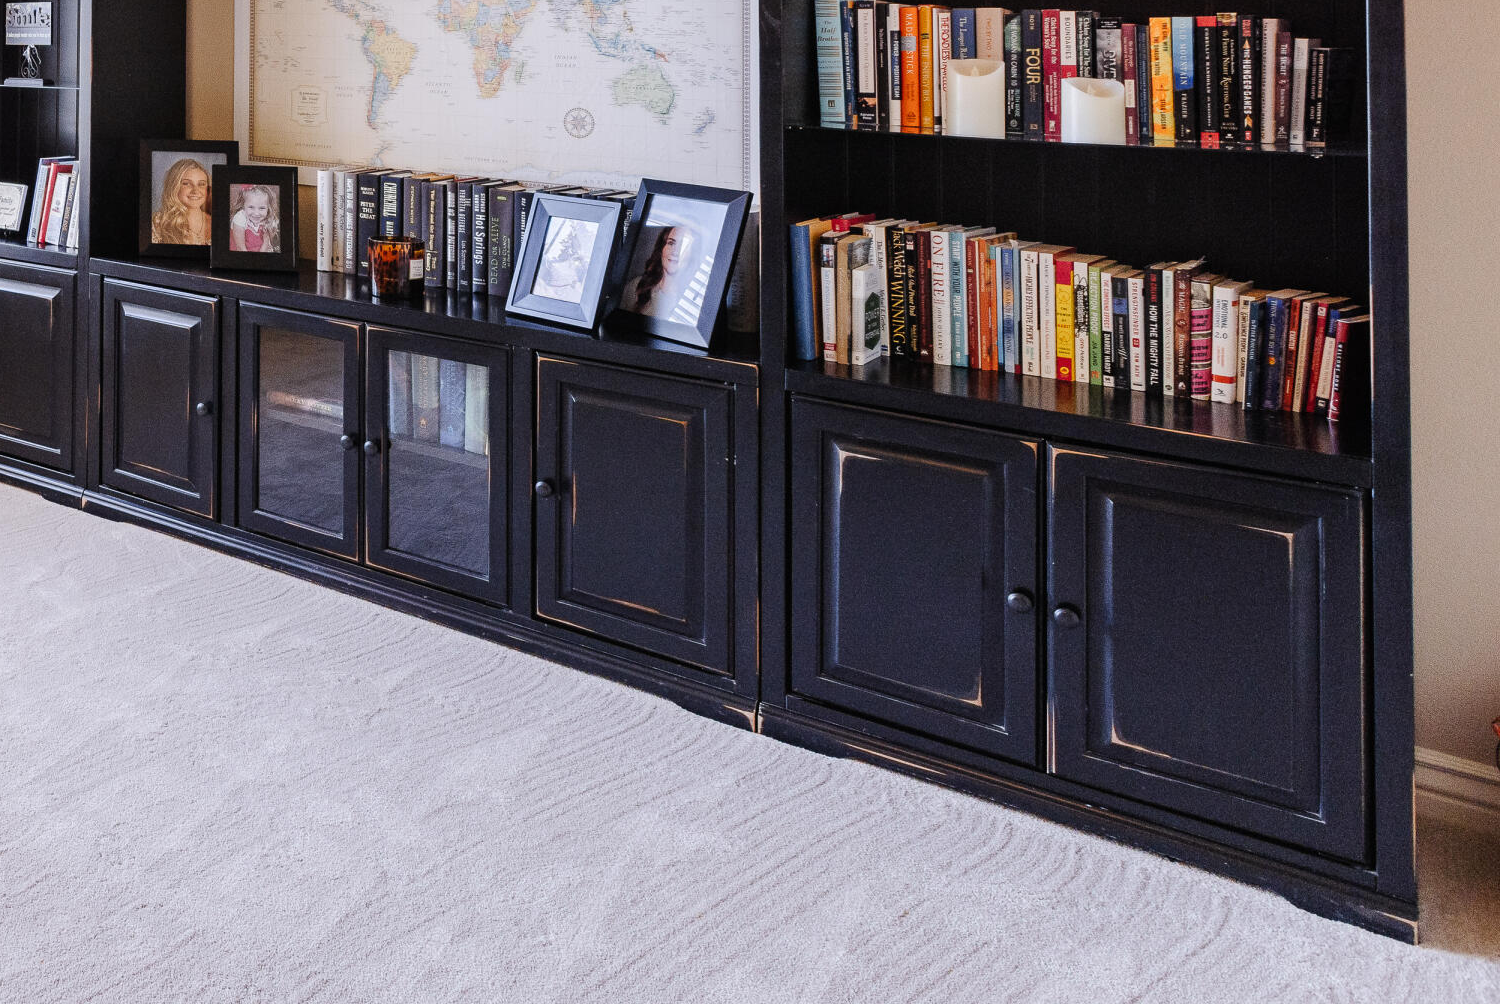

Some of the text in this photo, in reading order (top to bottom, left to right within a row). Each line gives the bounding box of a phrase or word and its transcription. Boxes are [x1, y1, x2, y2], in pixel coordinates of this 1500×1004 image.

[9, 7, 45, 26] Smile
[941, 17, 950, 60] THE ROAD LESS
[958, 17, 967, 46] The Longest
[906, 51, 914, 74] STICK
[1026, 48, 1041, 84] FOUR
[1180, 44, 1188, 85] MOUNTAIN
[1243, 49, 1251, 58] THE
[1243, 60, 1251, 89] HUNGER
[1243, 91, 1251, 115] GAMES
[384, 182, 397, 217] CHURCHILL
[474, 214, 485, 265] Hot Springs
[490, 217, 499, 284] DEAD OR ALIVE
[932, 235, 943, 256] ON
[952, 240, 961, 259] START
[933, 262, 944, 297] FIRE
[952, 261, 960, 277] WITH
[890, 230, 906, 344] Jack Welch WINNING
[953, 278, 961, 294] YOUR
[1025, 276, 1034, 294] HIGHLY
[1090, 271, 1098, 311] REJECTION
[954, 295, 962, 317] PEOPLE
[1026, 296, 1034, 324] EFFECTIVE
[1149, 305, 1157, 321] HOW
[1221, 299, 1229, 329] EMOTIONAL
[1026, 324, 1034, 345] PEOPLE
[1090, 312, 1098, 336] PROOF
[1150, 323, 1158, 337] THE
[1150, 339, 1158, 367] MIGHTY
[1335, 344, 1343, 372] WELCOME
[1150, 368, 1159, 385] FALL
